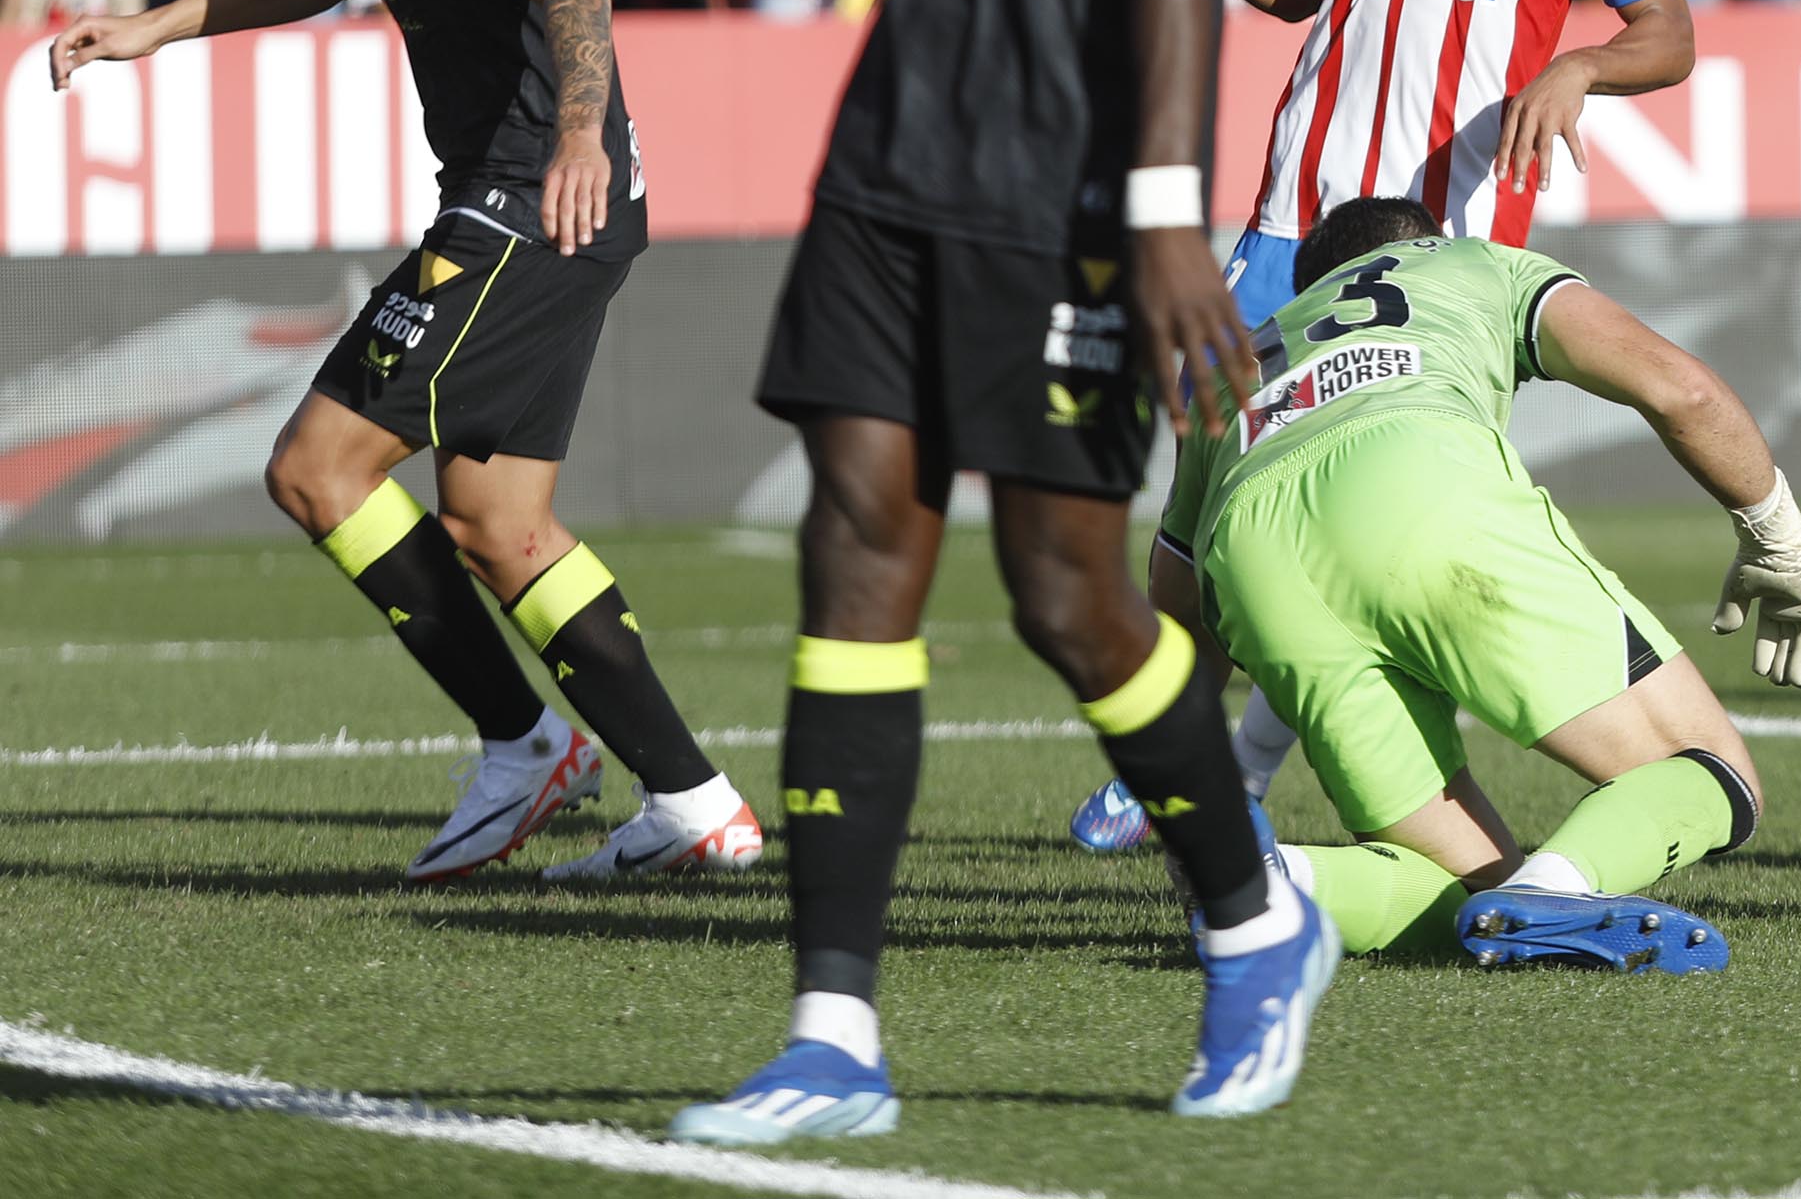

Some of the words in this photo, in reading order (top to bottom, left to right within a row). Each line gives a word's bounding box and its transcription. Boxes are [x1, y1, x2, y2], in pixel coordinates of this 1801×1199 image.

[371, 306, 426, 350] KUDU
[1316, 347, 1412, 384] POWER
[1318, 361, 1414, 404] HORSE
